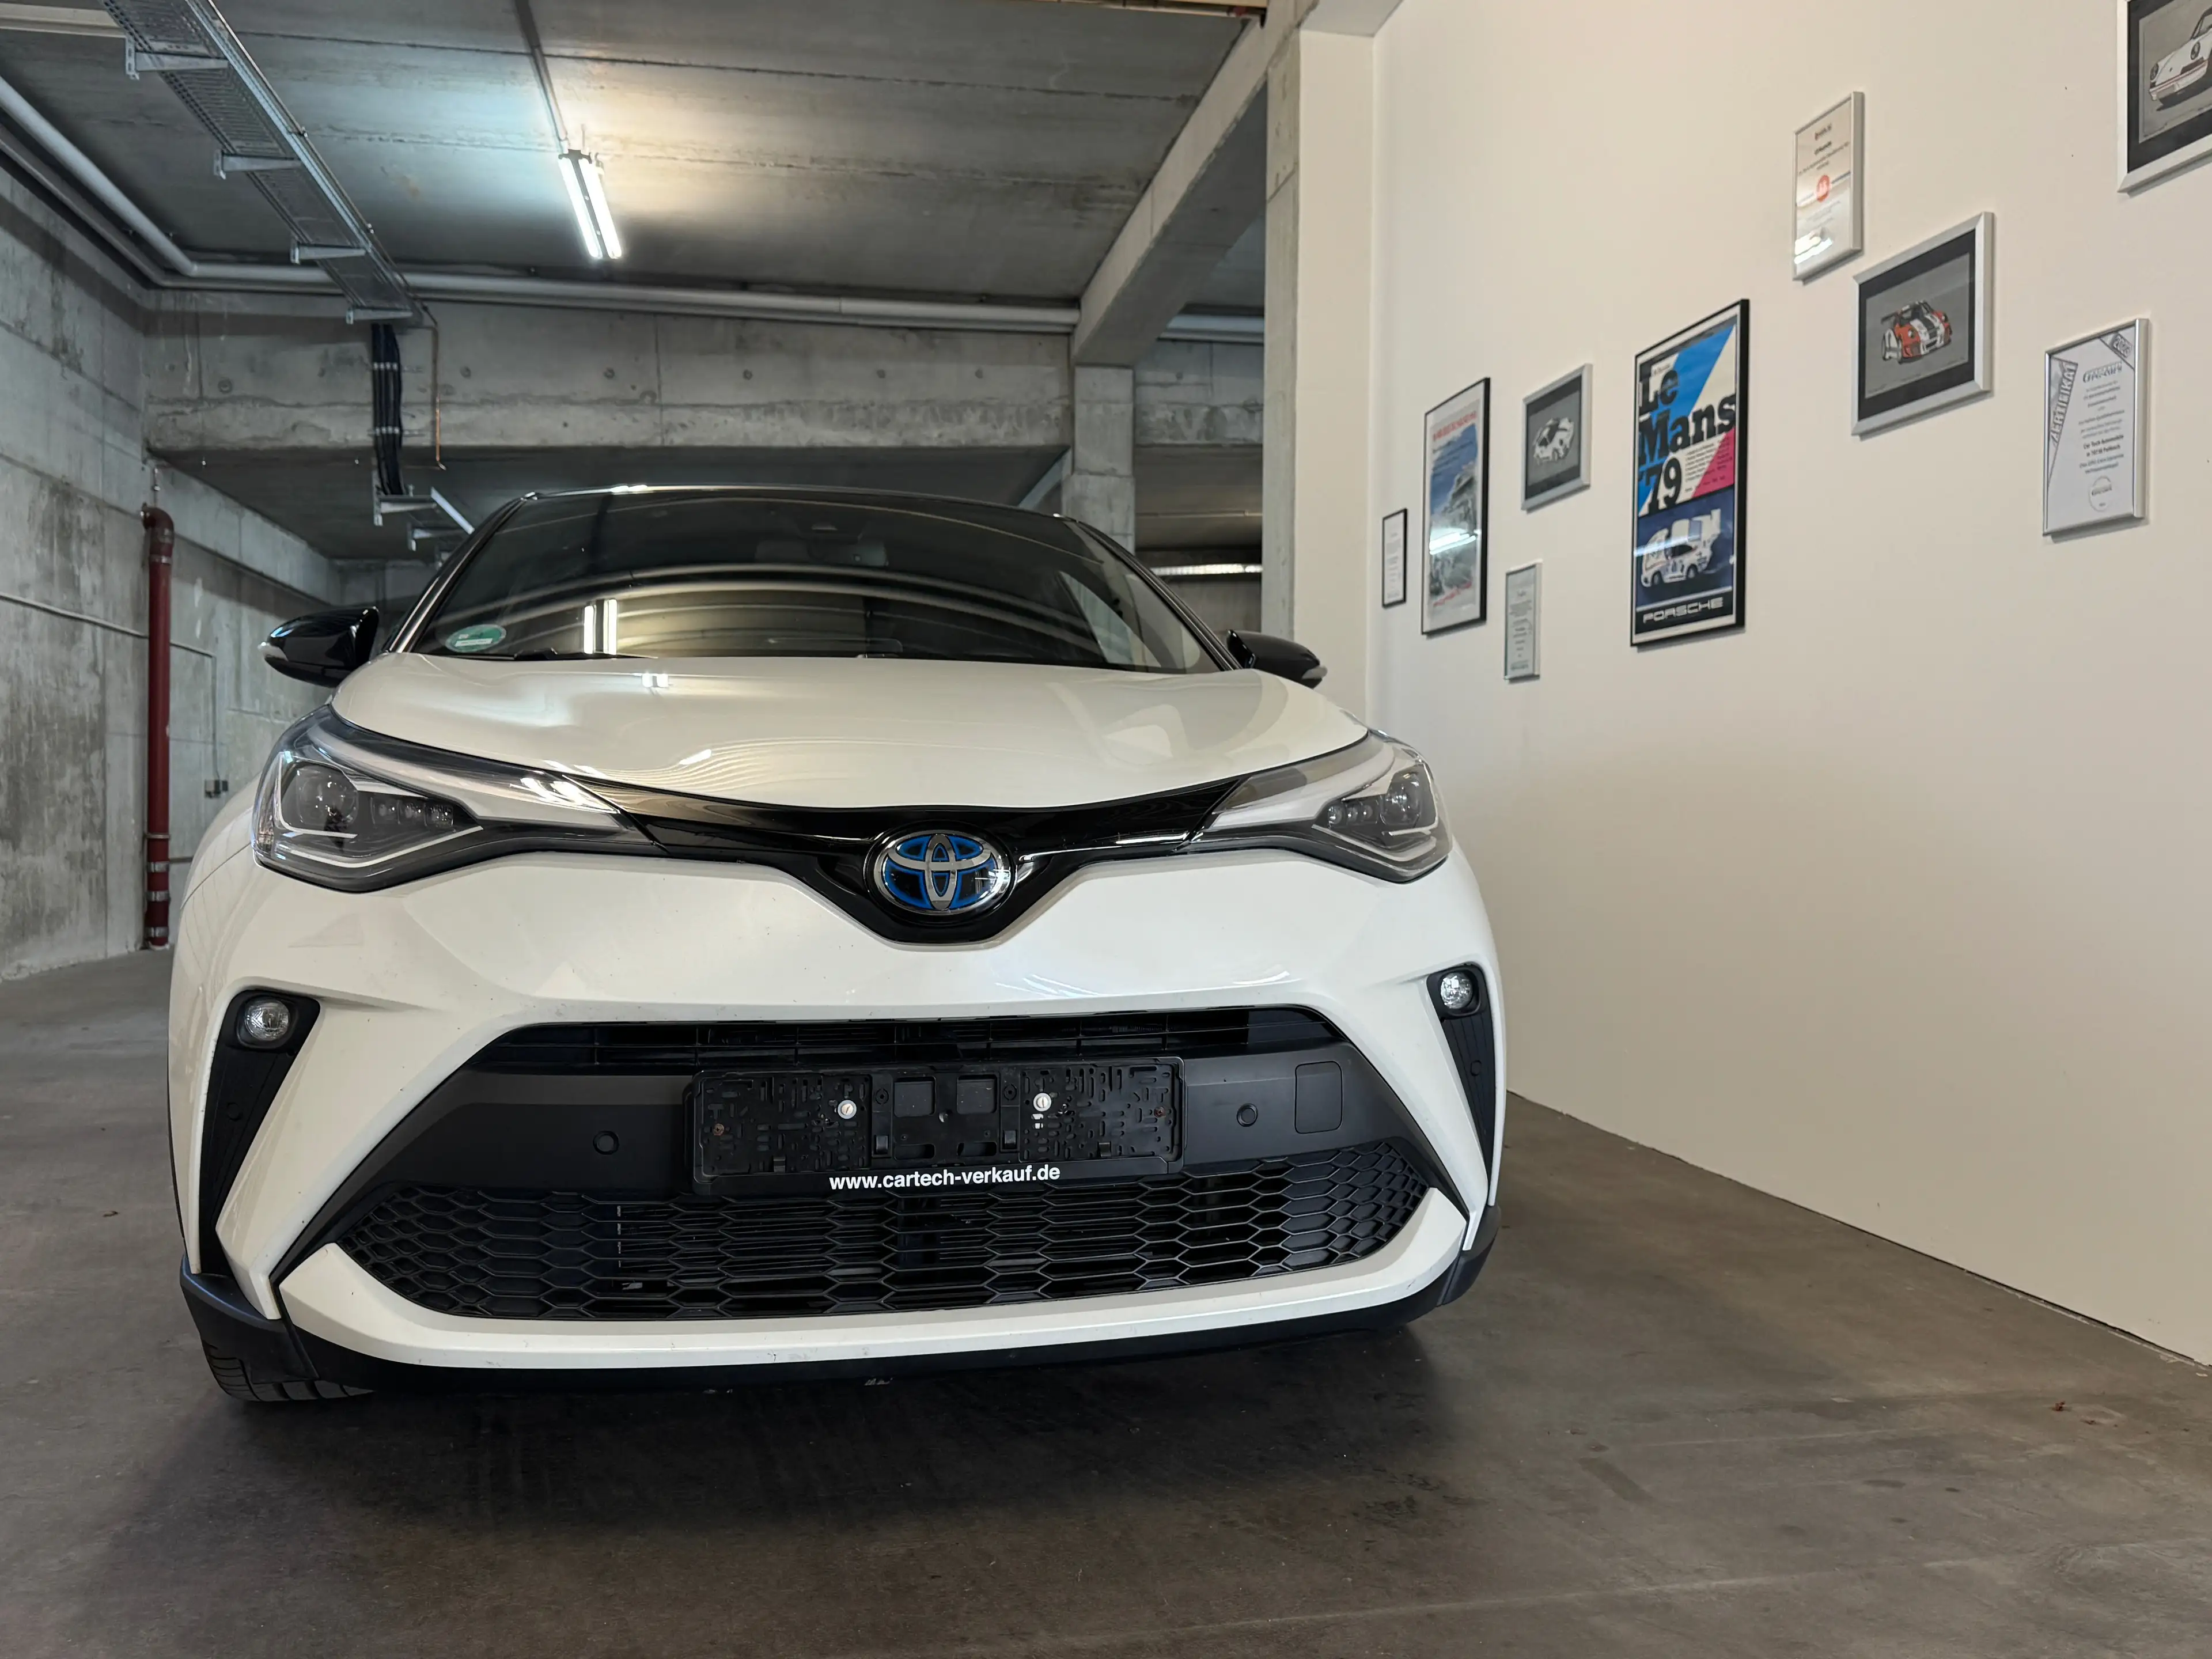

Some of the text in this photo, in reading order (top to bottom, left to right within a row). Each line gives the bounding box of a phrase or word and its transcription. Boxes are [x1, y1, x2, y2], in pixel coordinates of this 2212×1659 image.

[1639, 364, 1679, 416] Le
[1638, 393, 1736, 464] Mans
[1643, 597, 1724, 624] PORSCHE
[830, 1164, 1060, 1190] www.cartech-verkauf.de
